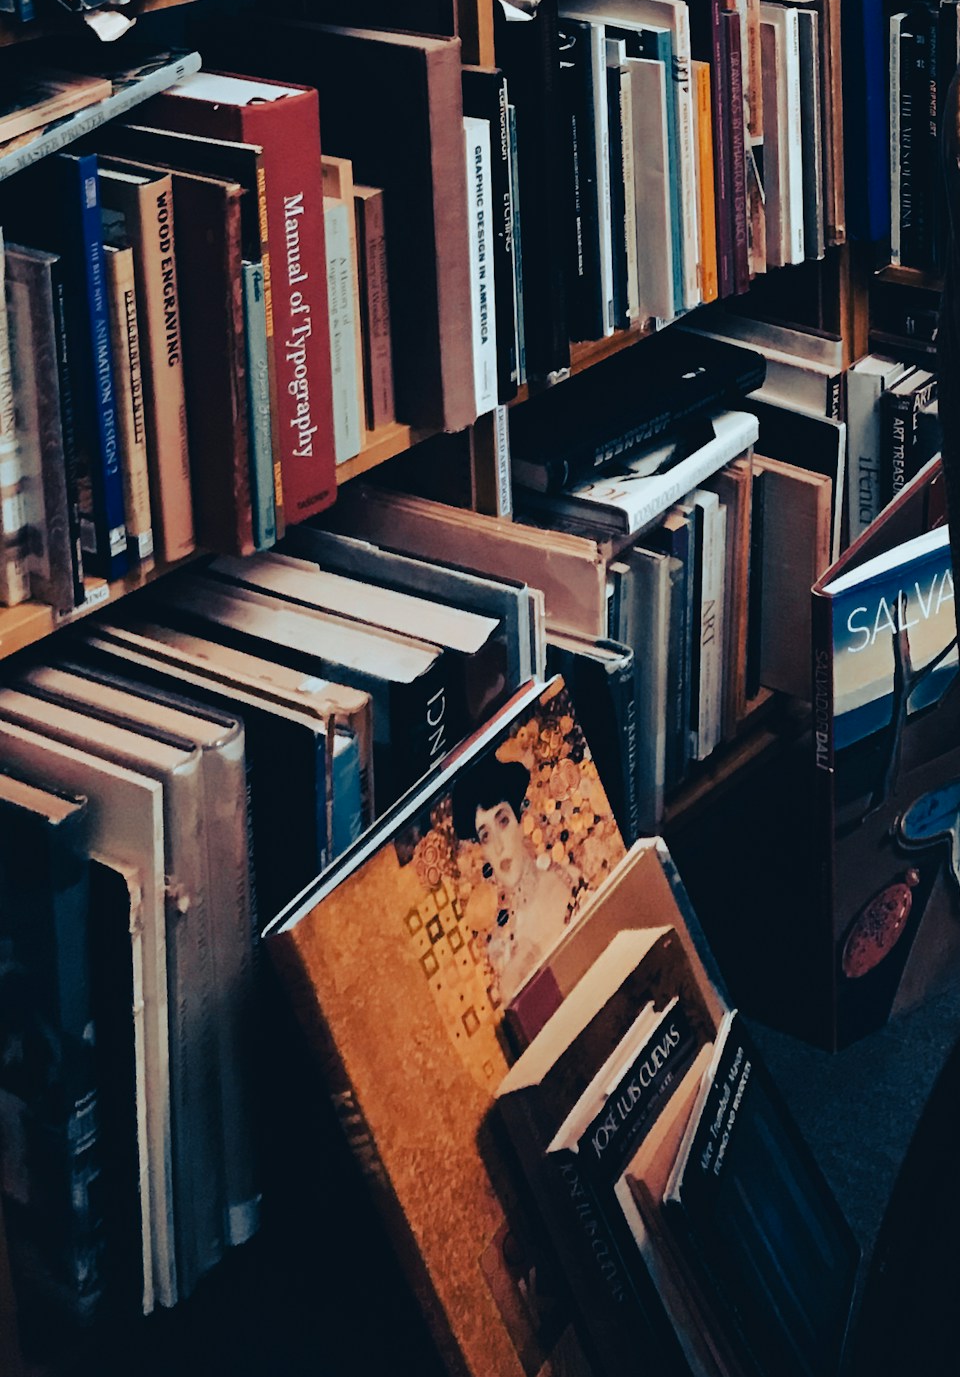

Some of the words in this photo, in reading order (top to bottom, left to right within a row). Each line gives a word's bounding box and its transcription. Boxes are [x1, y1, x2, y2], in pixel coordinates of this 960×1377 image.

[474, 146, 484, 206] GRAPHIC
[155, 192, 172, 254] WOOD
[281, 191, 308, 287] Manual
[476, 210, 486, 260] DESIGN
[478, 264, 486, 278] IN
[159, 257, 181, 368] ENGRAVING
[288, 292, 311, 314] of
[479, 282, 489, 344] AMERICA
[285, 318, 318, 459] Typography
[847, 571, 955, 652] SALVA
[615, 1084, 643, 1118] LUIS
[637, 1023, 681, 1088] CUEVAS
